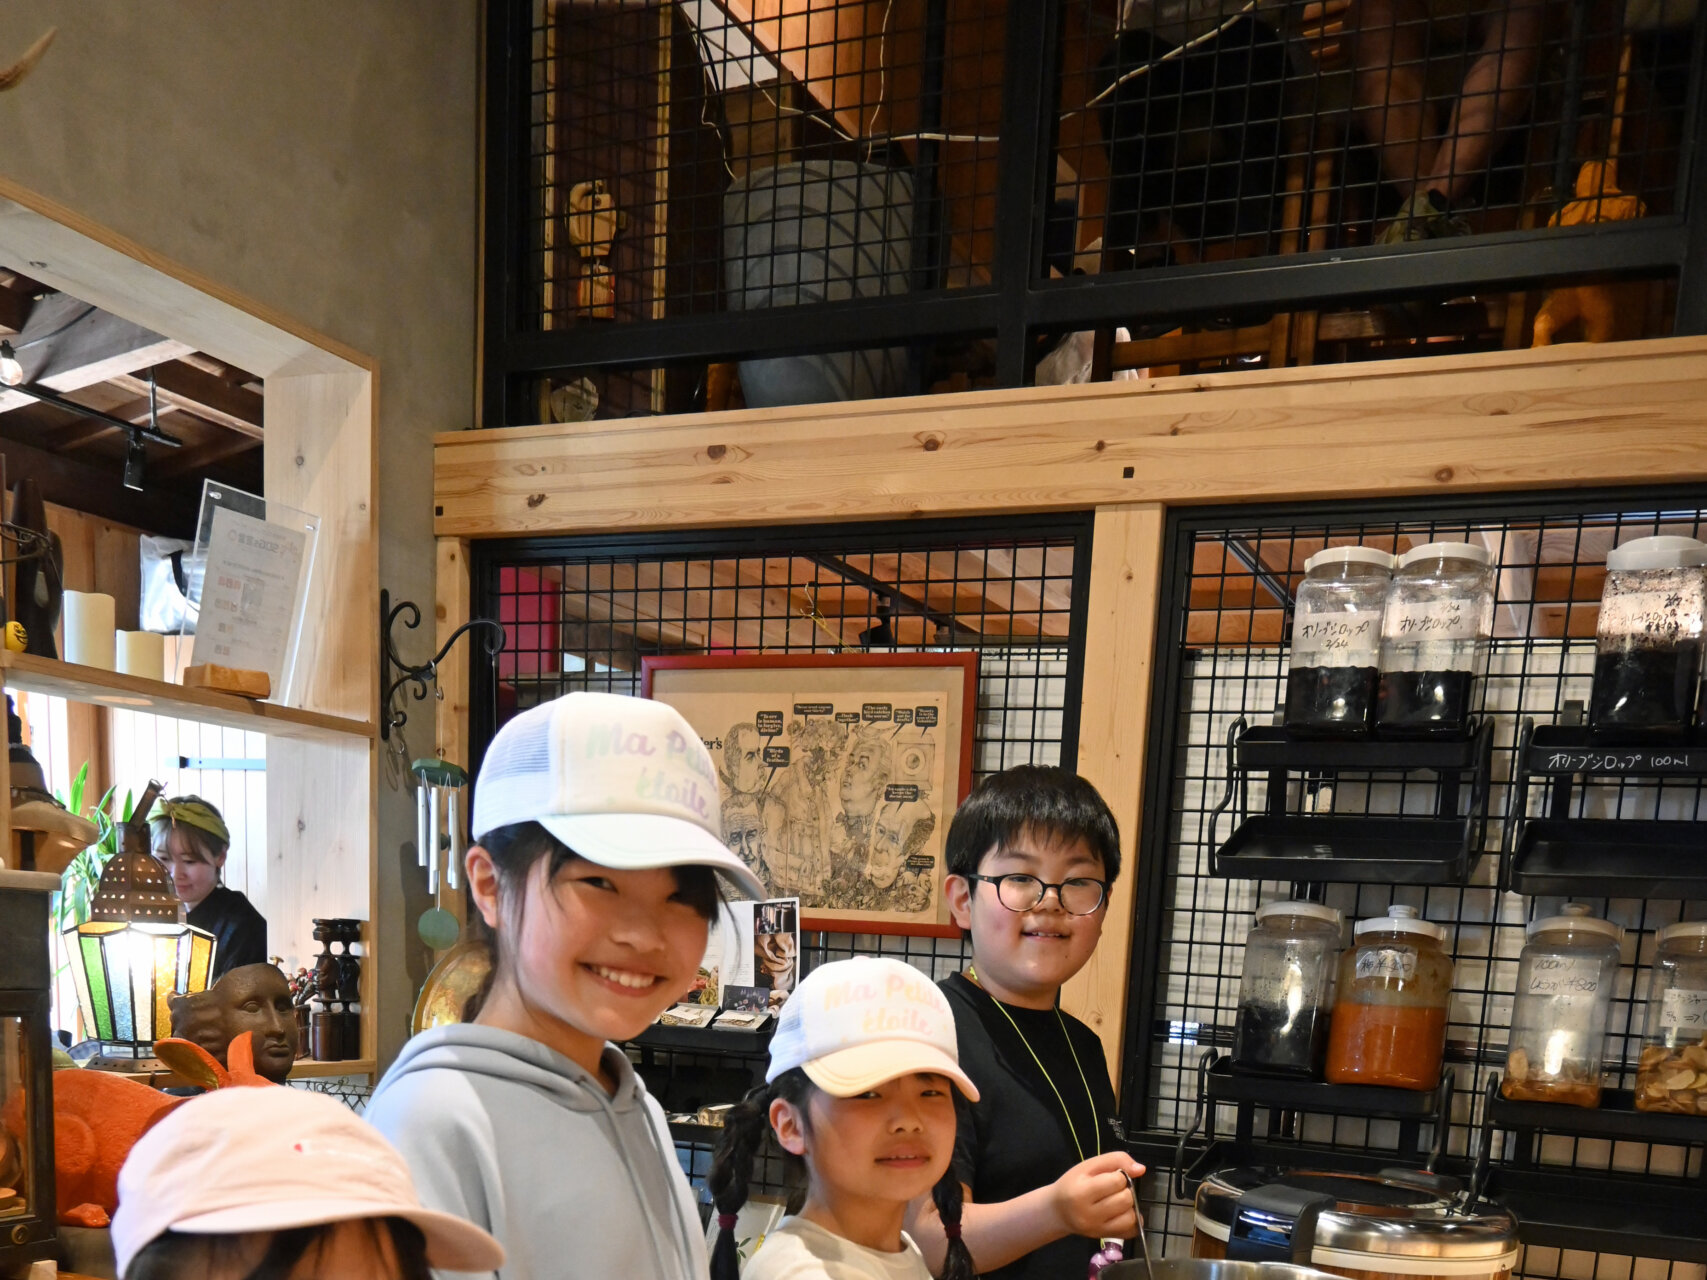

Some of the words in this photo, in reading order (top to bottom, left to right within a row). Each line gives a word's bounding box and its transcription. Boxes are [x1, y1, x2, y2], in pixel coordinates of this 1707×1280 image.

[586, 722, 656, 759] Ma
[1548, 753, 1642, 770] オリーブシロップ
[1650, 754, 1689, 768] 100ml
[824, 981, 877, 1012] Ma
